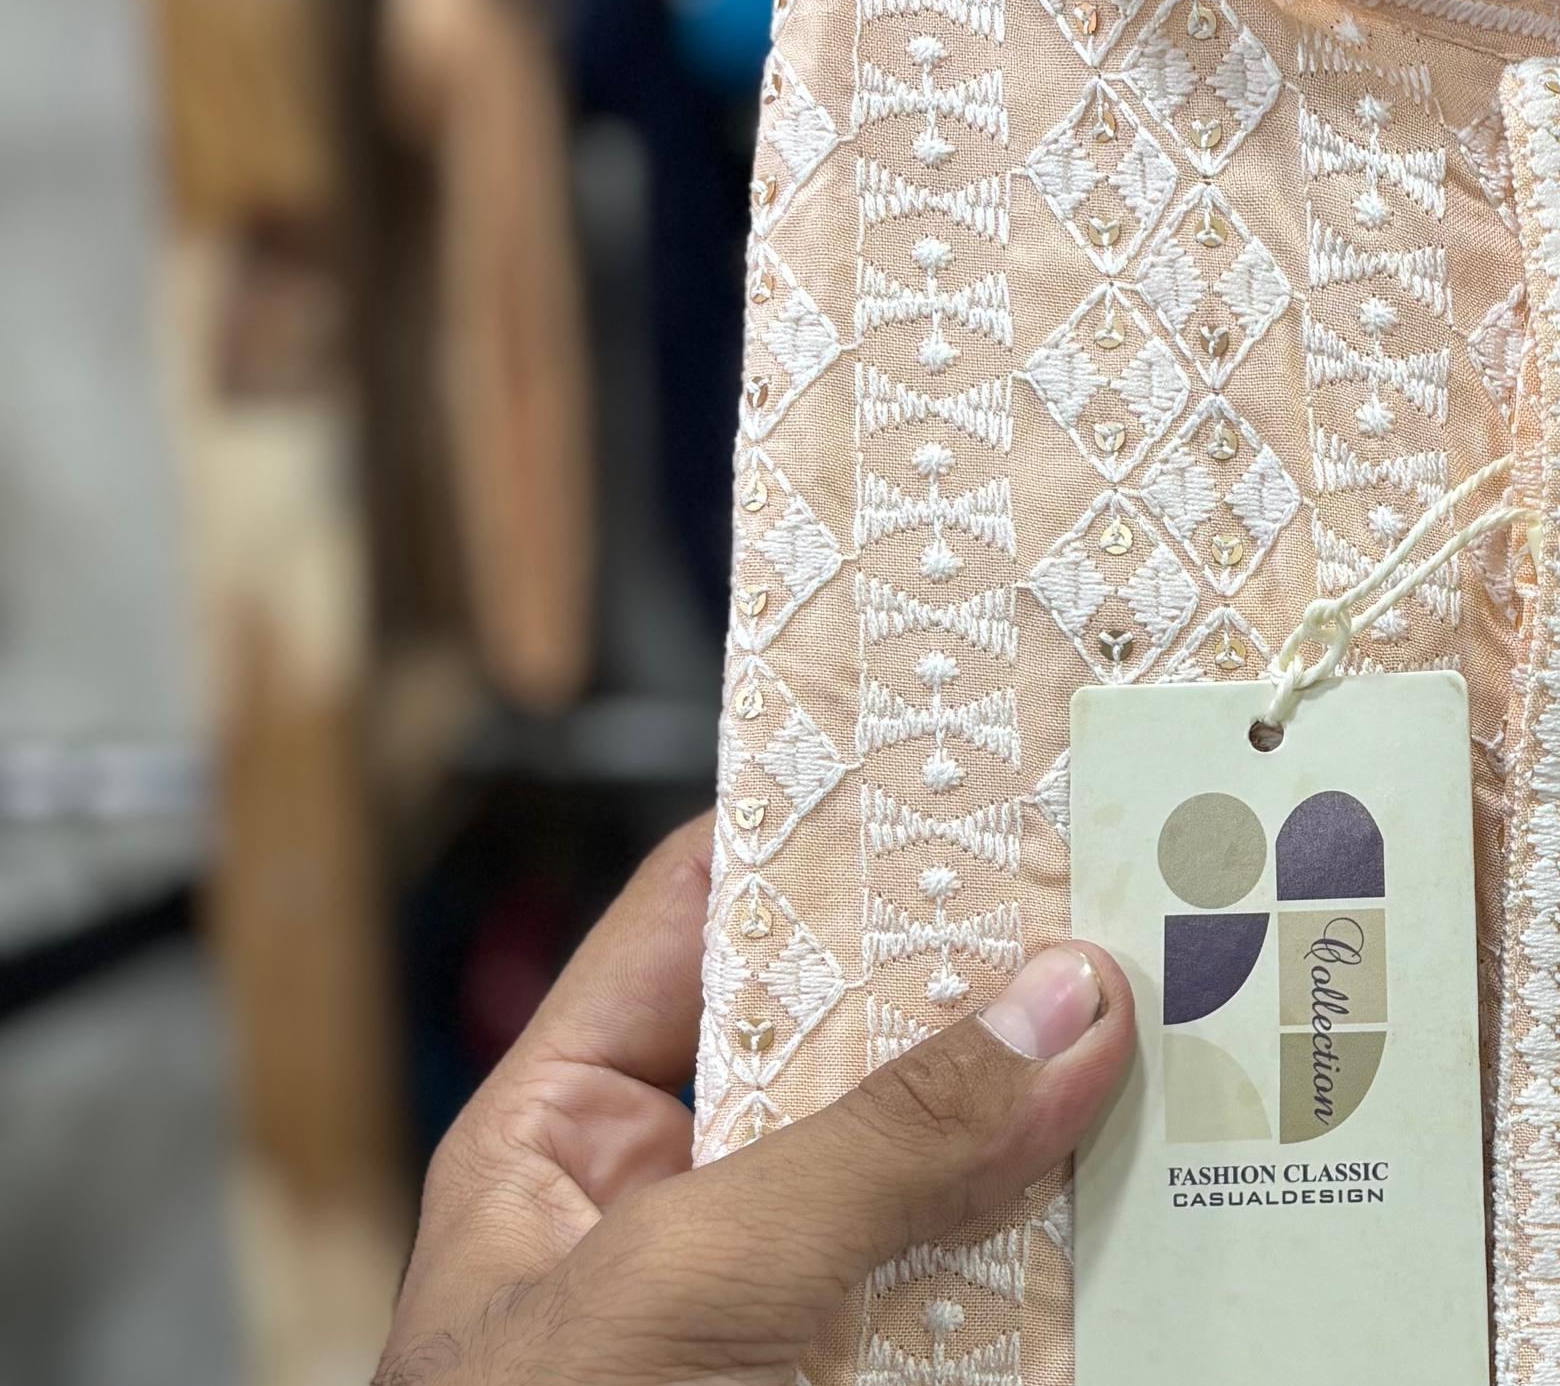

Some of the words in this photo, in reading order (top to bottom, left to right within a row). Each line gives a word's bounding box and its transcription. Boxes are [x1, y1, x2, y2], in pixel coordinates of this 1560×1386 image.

[1304, 917, 1364, 1126] Collection
[1168, 1165, 1276, 1186] FASHION
[1283, 1162, 1389, 1182] CLASSIC
[1173, 1188, 1384, 1208] CASUALDESIGN
